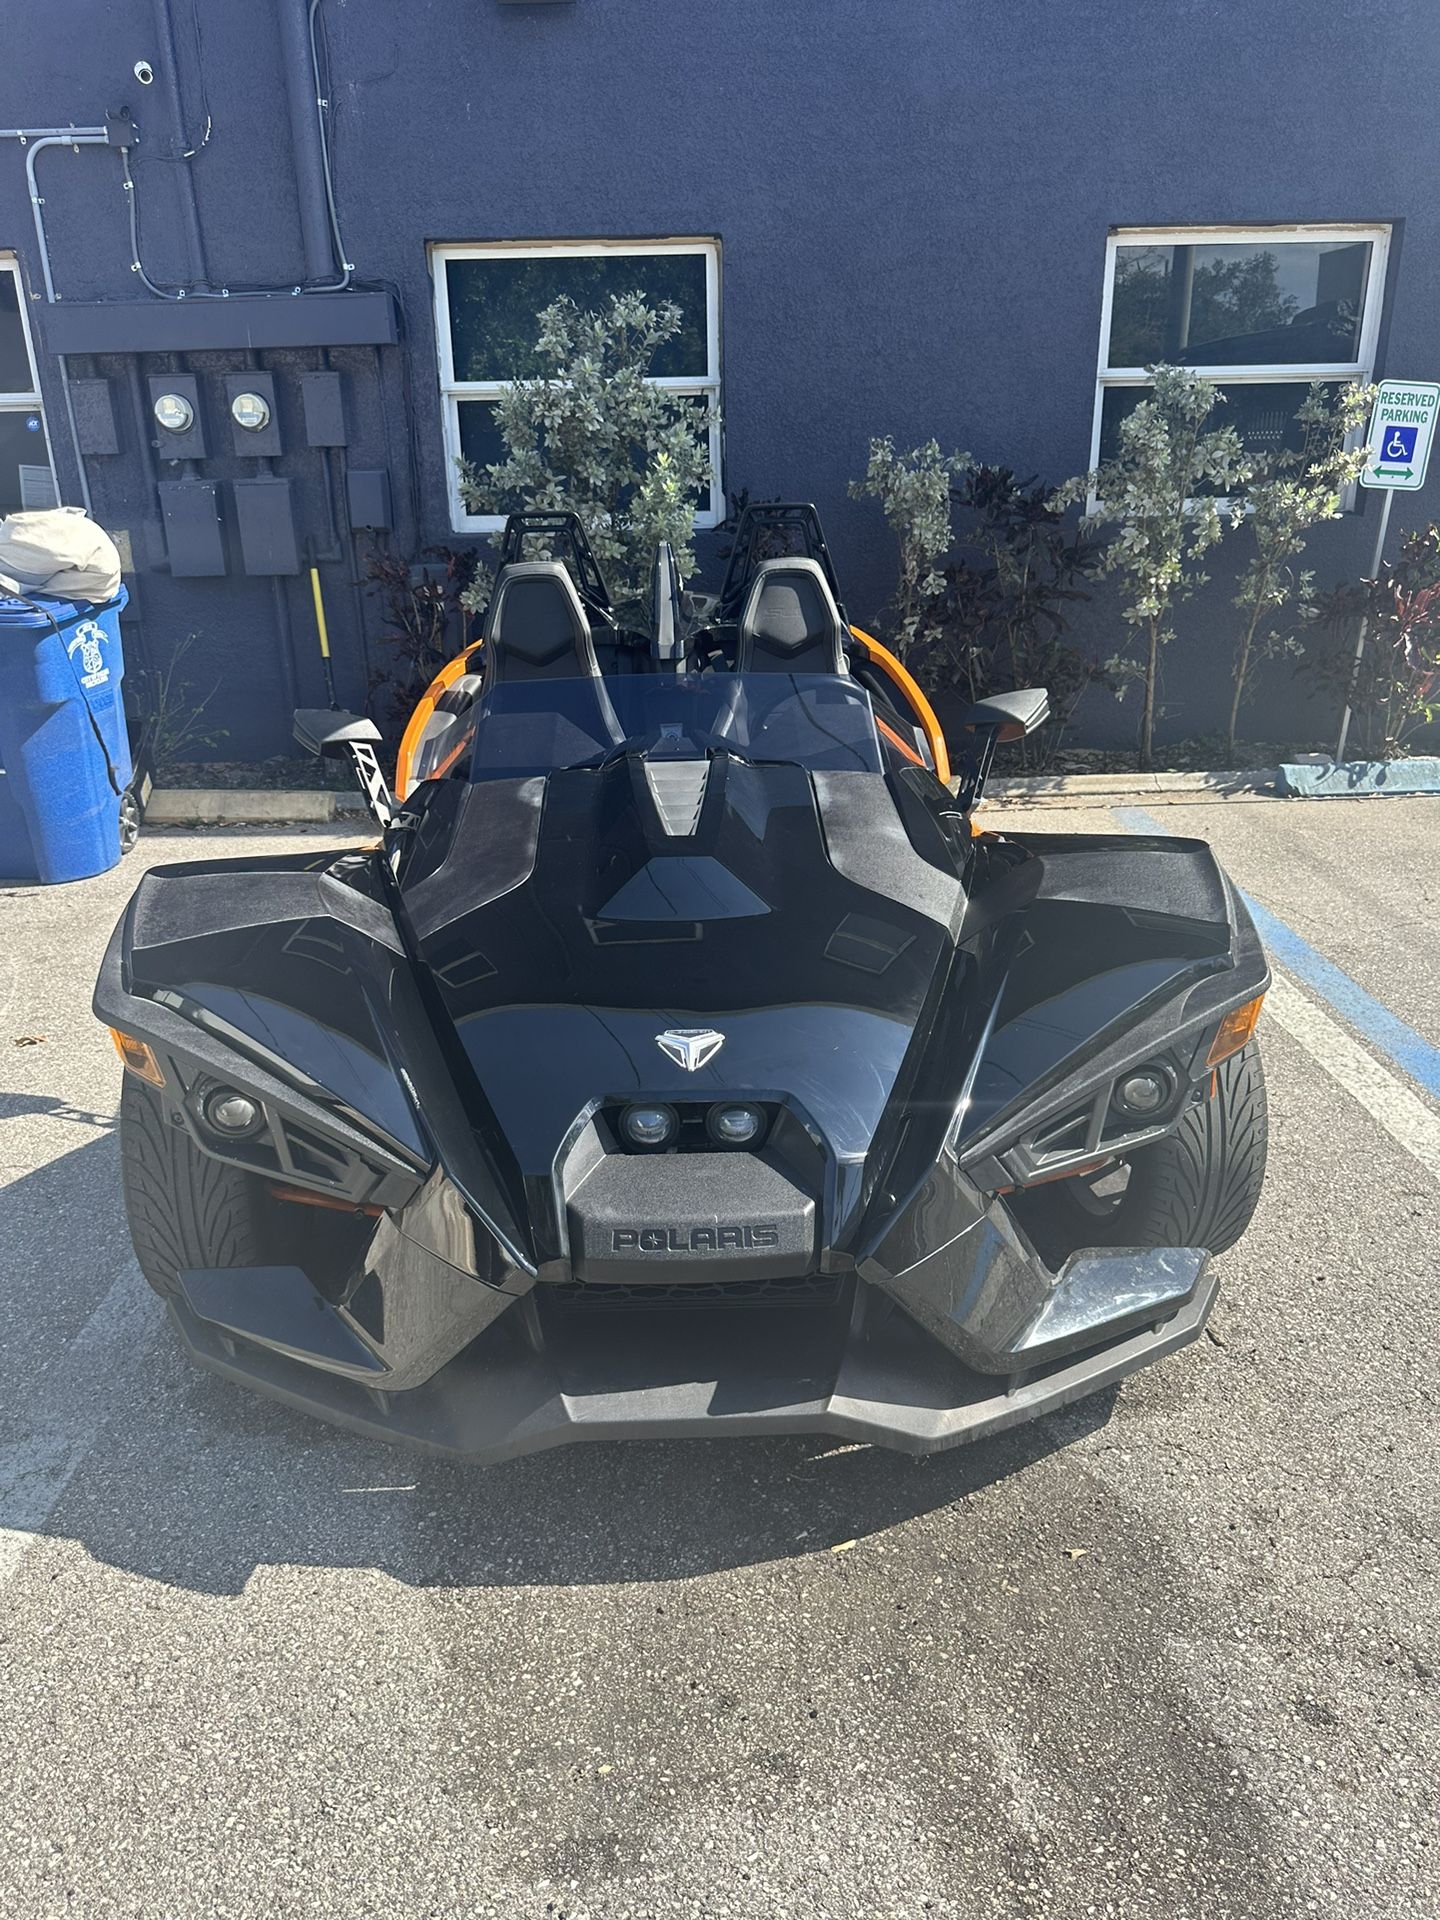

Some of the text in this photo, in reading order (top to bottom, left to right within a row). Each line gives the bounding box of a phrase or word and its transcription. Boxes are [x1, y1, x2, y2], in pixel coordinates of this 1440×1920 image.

[1380, 391, 1435, 407] RESERVED
[1381, 408, 1428, 423] PARKING
[611, 1224, 779, 1252] POLARIS
